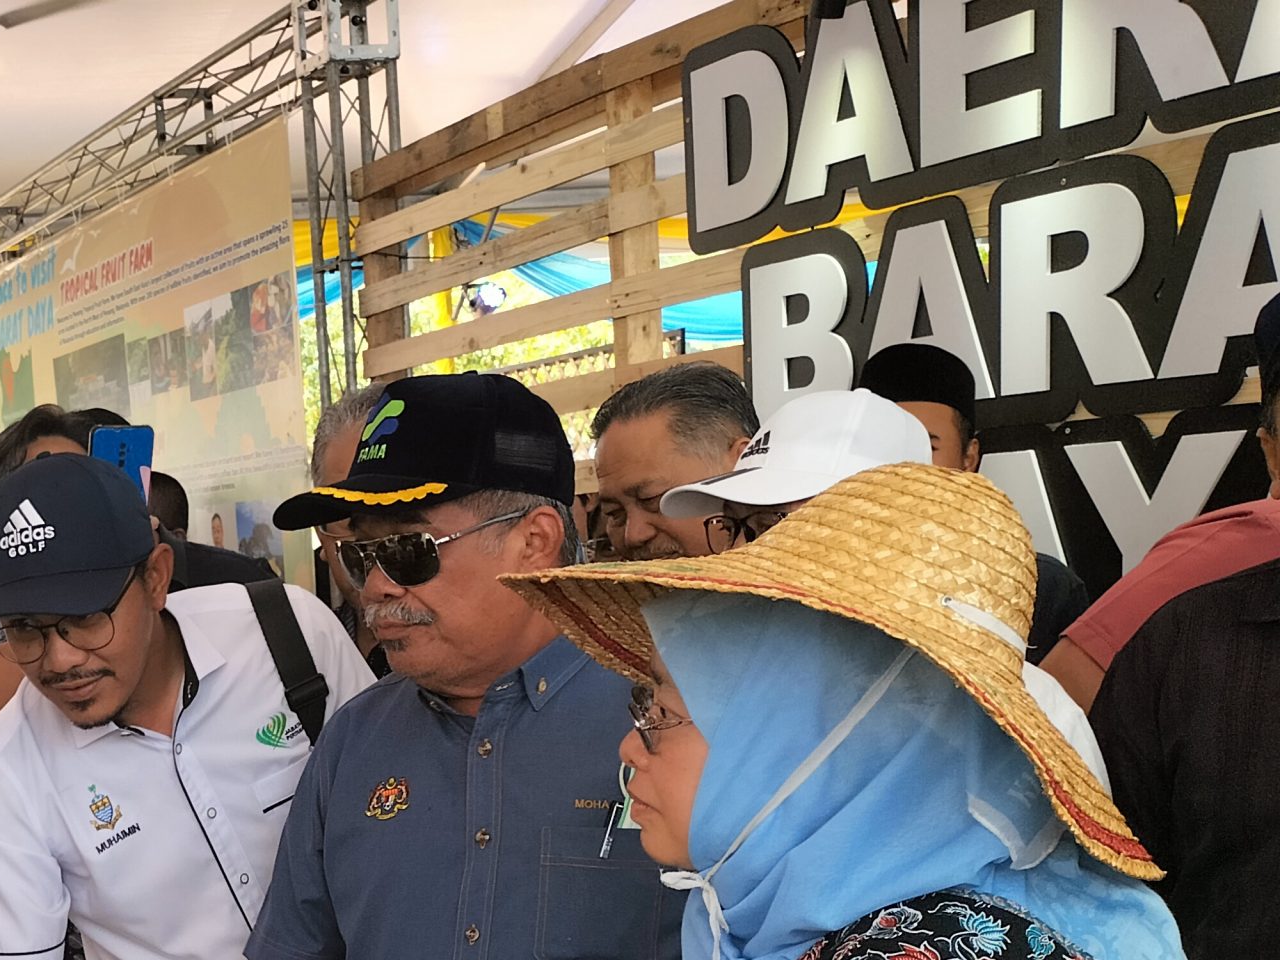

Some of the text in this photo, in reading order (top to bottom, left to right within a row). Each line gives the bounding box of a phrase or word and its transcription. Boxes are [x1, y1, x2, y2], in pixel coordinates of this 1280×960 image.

[16, 263, 27, 296] to
[31, 246, 56, 289] visit
[60, 240, 153, 306] TROPICAL FRUIT FARM
[27, 294, 54, 337] DAYA
[357, 443, 387, 464] FAMA
[0, 525, 55, 549] adidas
[8, 541, 45, 558] GOLF
[95, 822, 141, 855] MUHAIMIN
